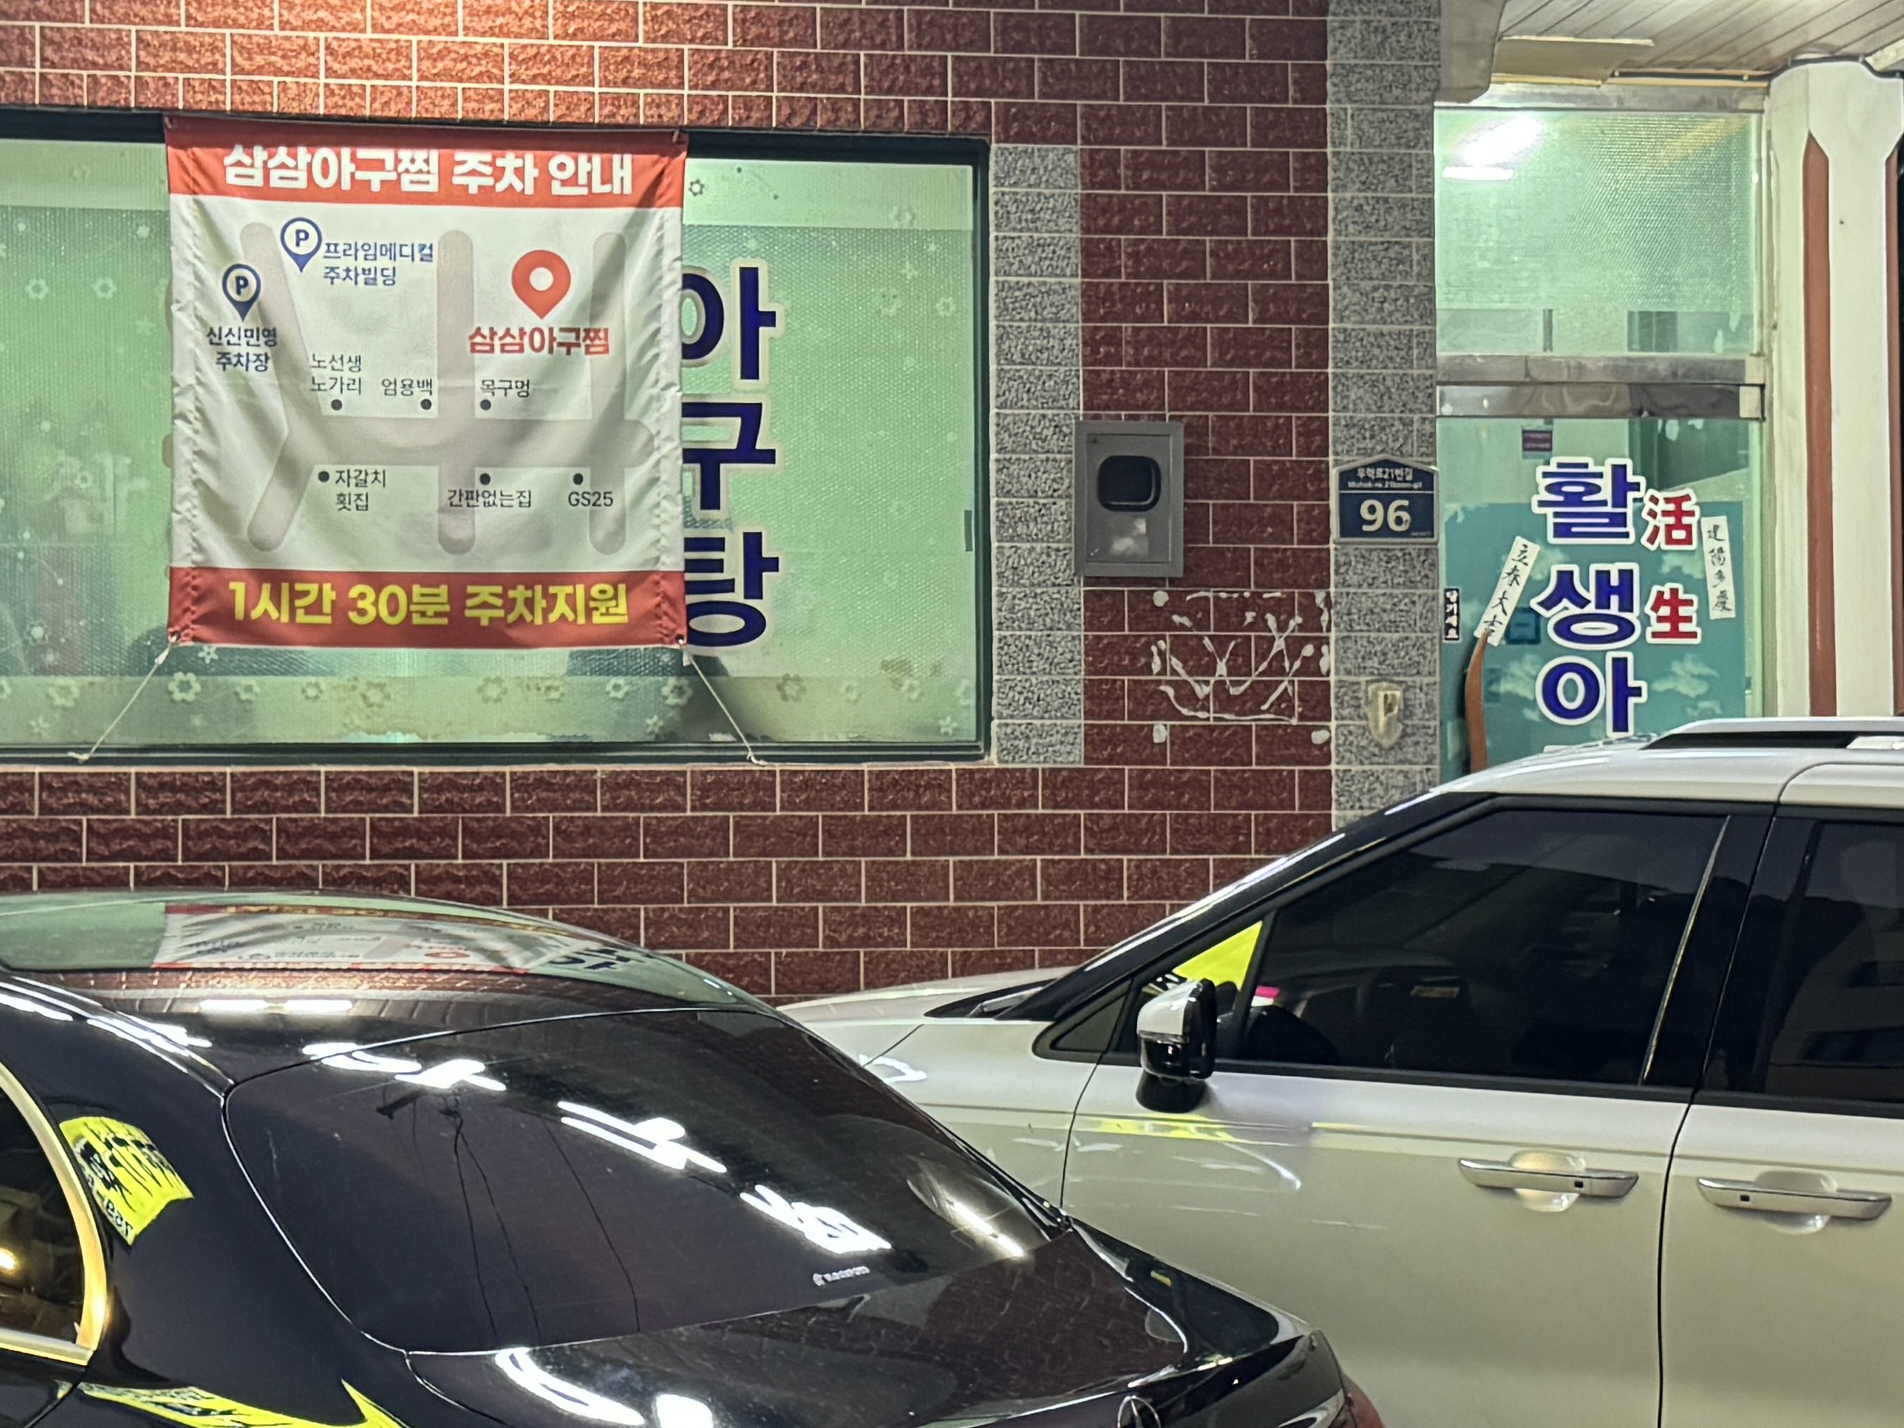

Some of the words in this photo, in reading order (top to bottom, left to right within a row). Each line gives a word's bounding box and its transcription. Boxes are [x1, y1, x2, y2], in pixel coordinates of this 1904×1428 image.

[223, 143, 439, 193] 삼삼아구찜
[452, 150, 538, 196] 주차
[548, 152, 633, 196] 안내
[322, 241, 435, 263] 프라임메디컬
[322, 266, 397, 287] 주차빌딩
[468, 326, 610, 356] 삼삼아구찜
[215, 351, 270, 372] 주차장
[310, 353, 363, 373] 노선생
[309, 376, 363, 395] 노가리
[381, 377, 433, 397] 엄용백
[480, 378, 531, 398] 목구멍
[334, 469, 387, 489] 자갈치
[336, 492, 369, 512] 횟집
[447, 489, 532, 509] 간판없는집
[568, 491, 614, 508] GS25
[1359, 498, 1412, 533] 96
[228, 580, 336, 624] 1시간
[347, 583, 451, 626] 30분
[464, 582, 629, 627] 주차지원
